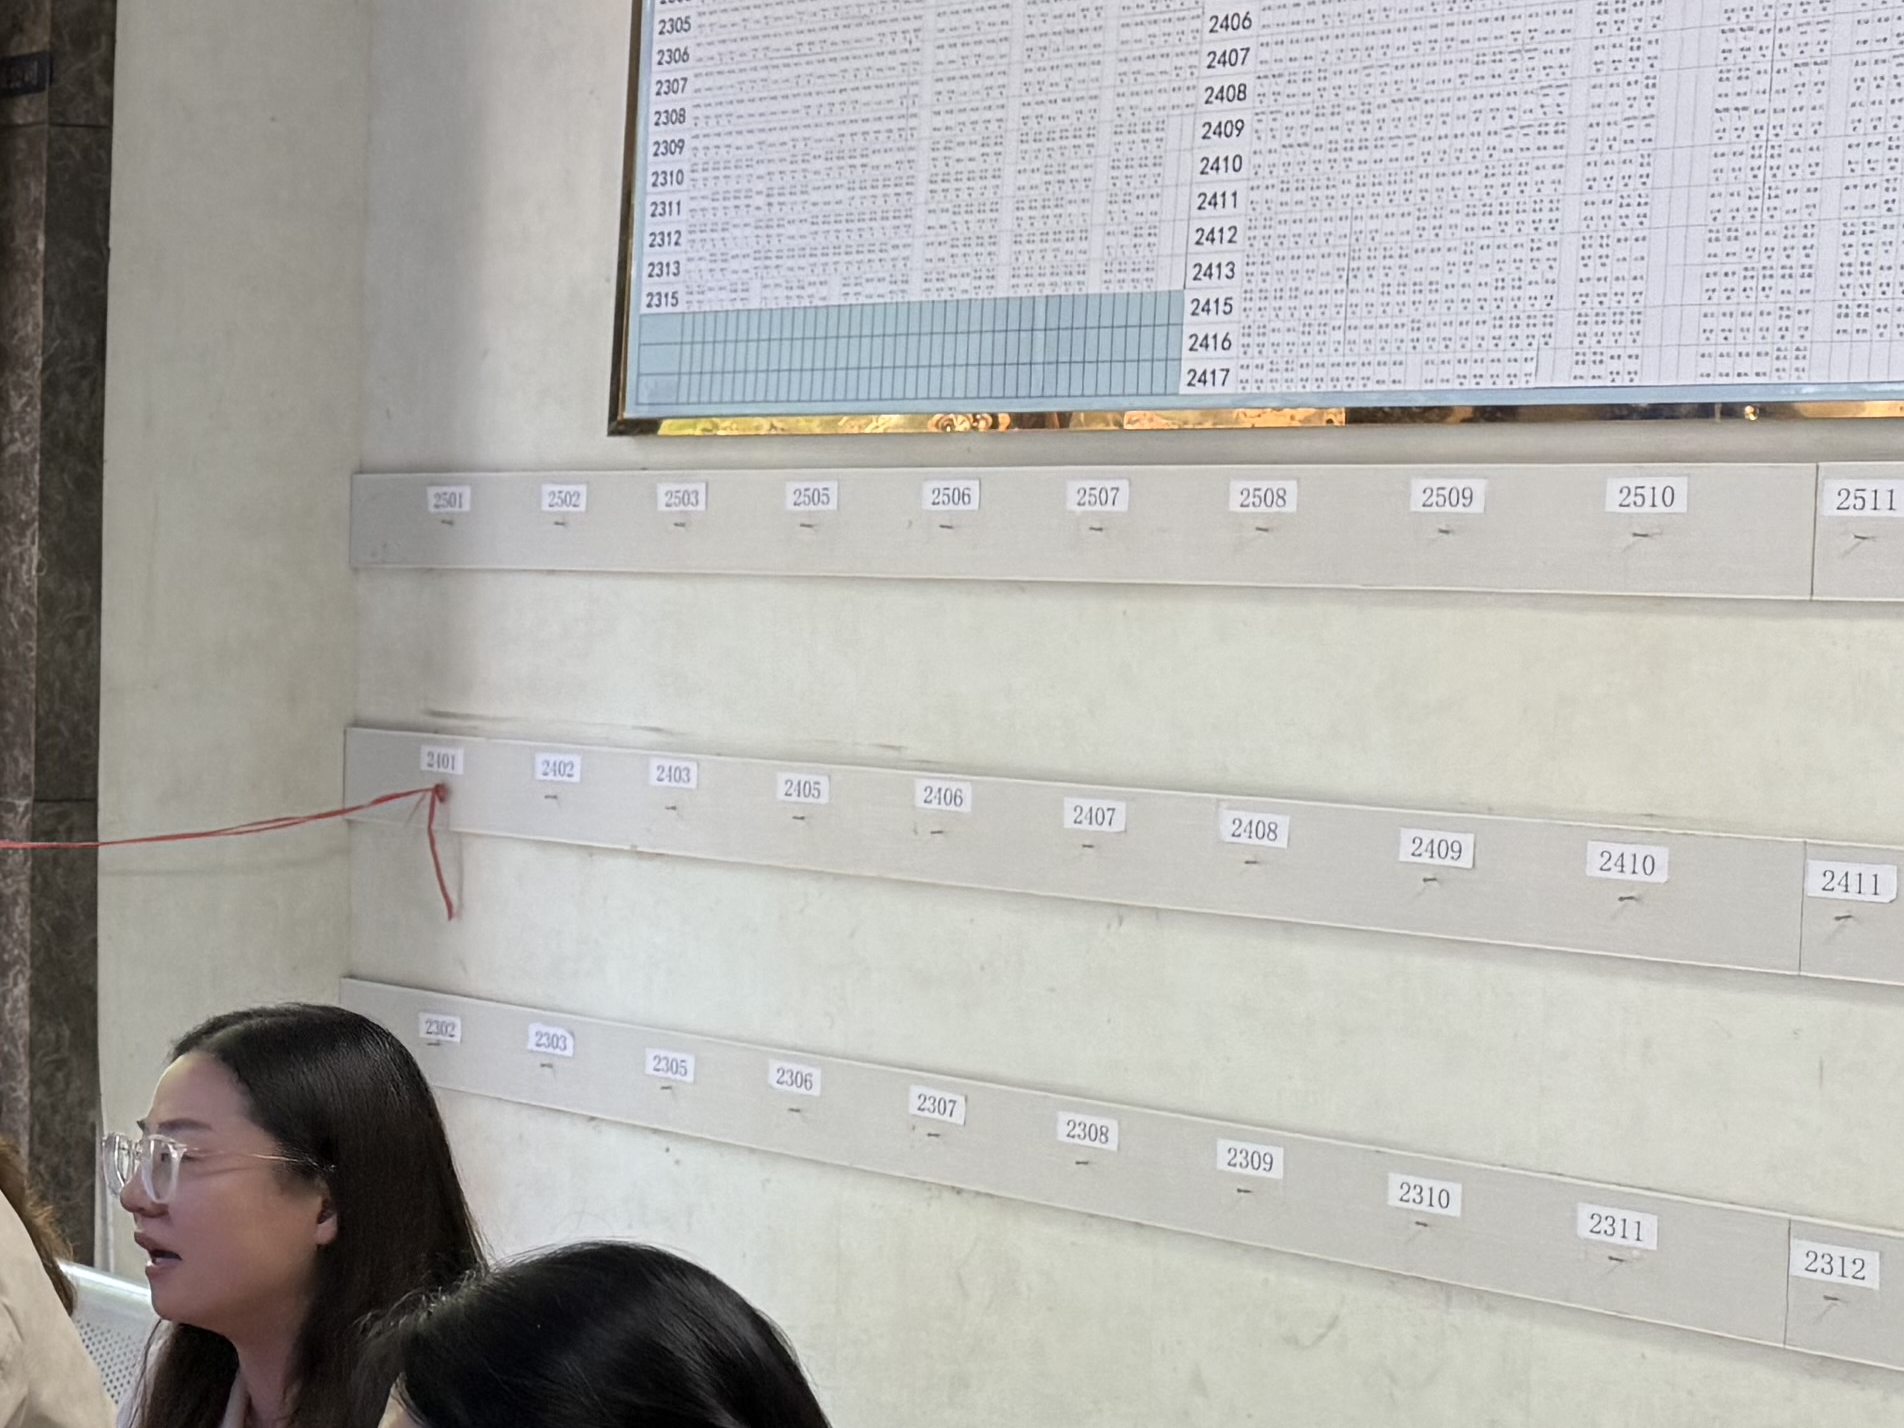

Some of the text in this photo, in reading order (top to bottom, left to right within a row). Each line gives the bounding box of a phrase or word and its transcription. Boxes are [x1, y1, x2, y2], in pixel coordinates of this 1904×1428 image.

[658, 16, 691, 35] 2305
[1209, 11, 1252, 33] 2406
[657, 46, 689, 65] 2306
[1207, 47, 1250, 69] 2407
[656, 77, 688, 96] 2307
[1205, 83, 1246, 104] 2408
[654, 108, 686, 126] 2308
[1202, 119, 1244, 140] 2409
[653, 139, 685, 157] 2309
[1200, 154, 1242, 175] 2410
[652, 169, 684, 187] 2310
[650, 200, 680, 217] 2311
[1197, 191, 1237, 210] 2411
[649, 230, 681, 248] 2312
[1195, 226, 1237, 245] 2412
[648, 260, 680, 278] 2313
[1193, 261, 1235, 281] 2413
[646, 291, 678, 308] 2315
[1191, 297, 1233, 316] 2415
[1189, 332, 1232, 351] 2416
[1187, 368, 1230, 387] 2417
[433, 486, 1895, 510] 2501 2502 2503 2505 2506 2507 2508 2509 2510 2511
[427, 751, 1879, 897] 2401 2402 2403 2405 2406 2407 2408 2409 2410 2411
[425, 1018, 1865, 1280] 2302 2303 2305 2306 2307 2308 2309 2310 2311 2312
